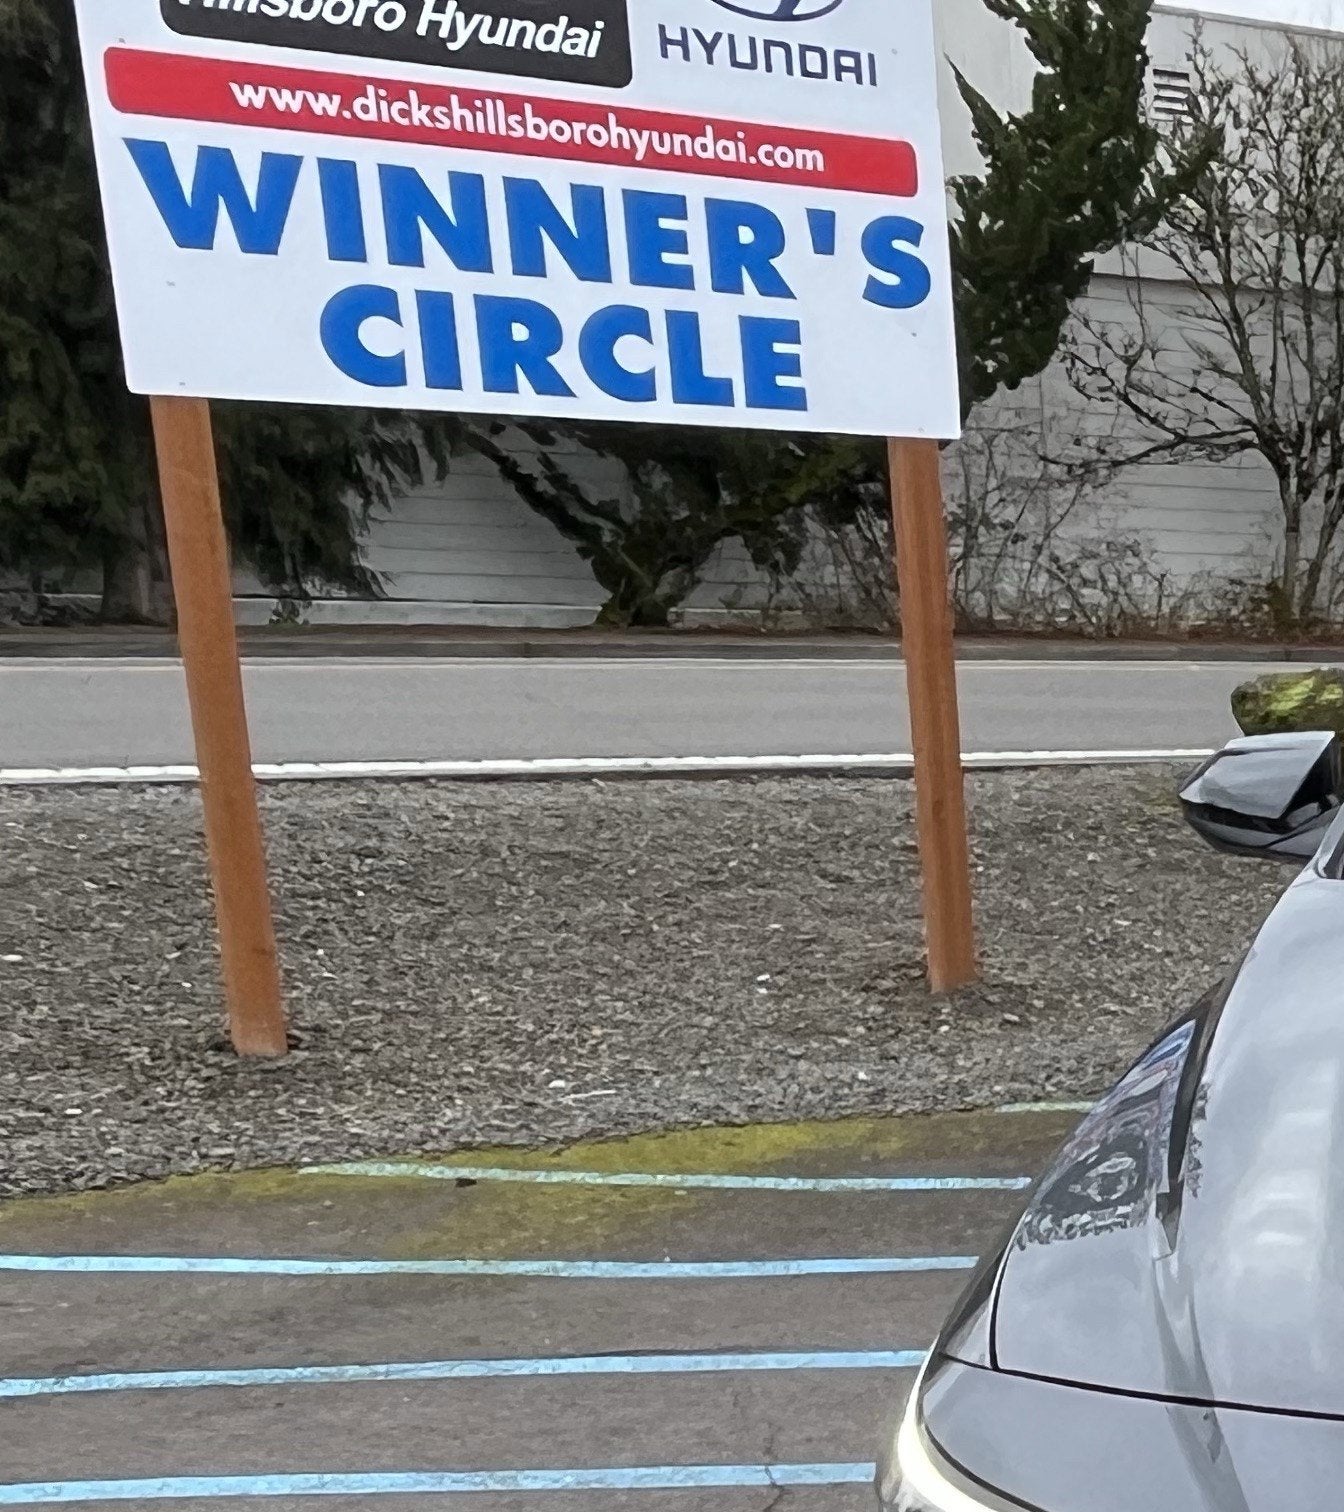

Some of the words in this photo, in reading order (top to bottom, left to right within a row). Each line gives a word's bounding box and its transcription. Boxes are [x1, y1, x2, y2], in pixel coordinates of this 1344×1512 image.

[178, 0, 407, 32] sboro
[415, 0, 605, 59] Hyundai
[658, 24, 877, 87] HYUNDAI
[229, 80, 825, 173] www.dickshillsborohyundai.com
[122, 137, 933, 310] WINNER'S
[319, 283, 809, 412] CIRCLE
